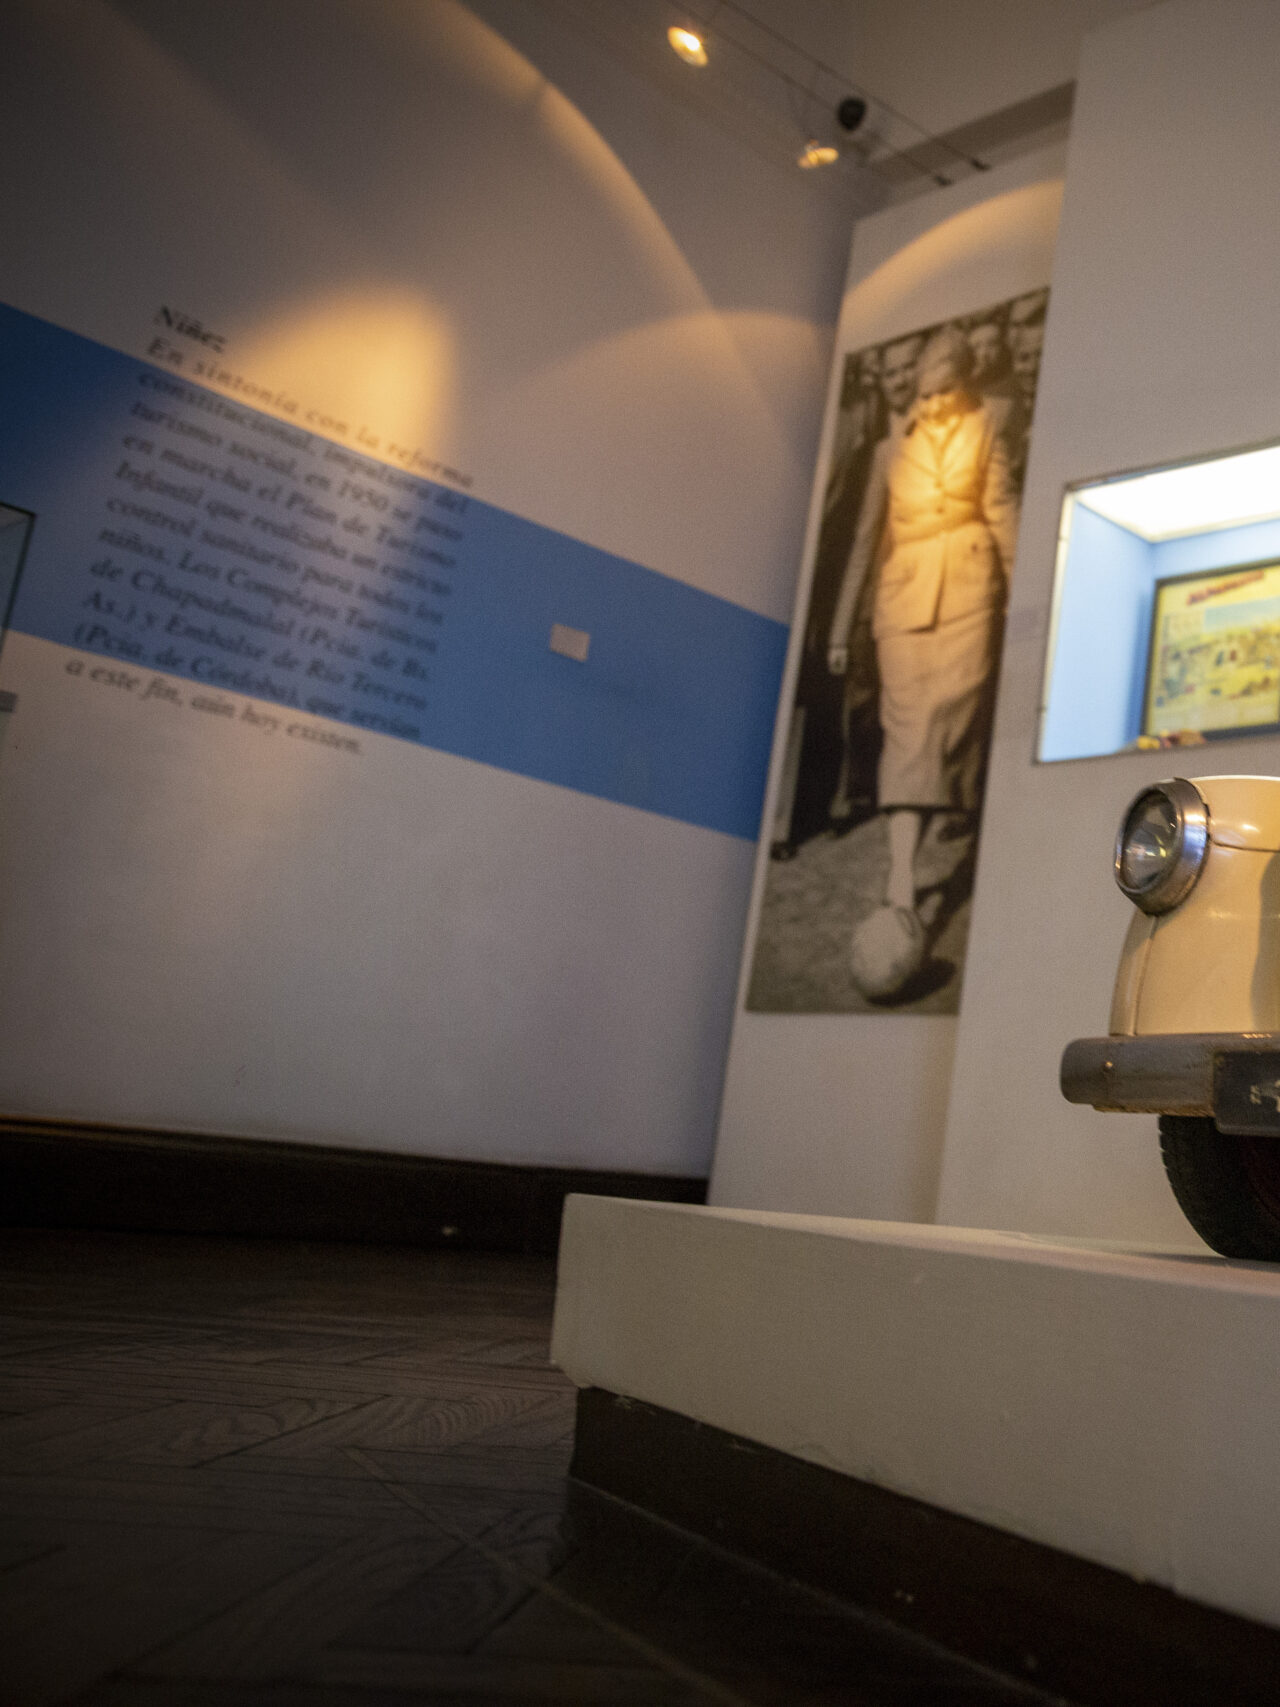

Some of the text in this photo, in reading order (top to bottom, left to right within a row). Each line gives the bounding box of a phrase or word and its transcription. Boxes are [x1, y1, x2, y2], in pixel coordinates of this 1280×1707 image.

[130, 400, 222, 446] turismo
[305, 473, 330, 489] en
[337, 480, 388, 511] 1950
[147, 336, 475, 487] En sintonía con la reforma
[122, 434, 153, 454] en
[257, 483, 281, 502] el
[285, 491, 337, 523] Plan
[342, 516, 368, 535] de
[89, 557, 123, 581] de
[370, 649, 395, 669] de
[155, 647, 184, 670] de
[271, 649, 300, 670] de
[64, 660, 83, 675] a
[89, 666, 139, 691] este
